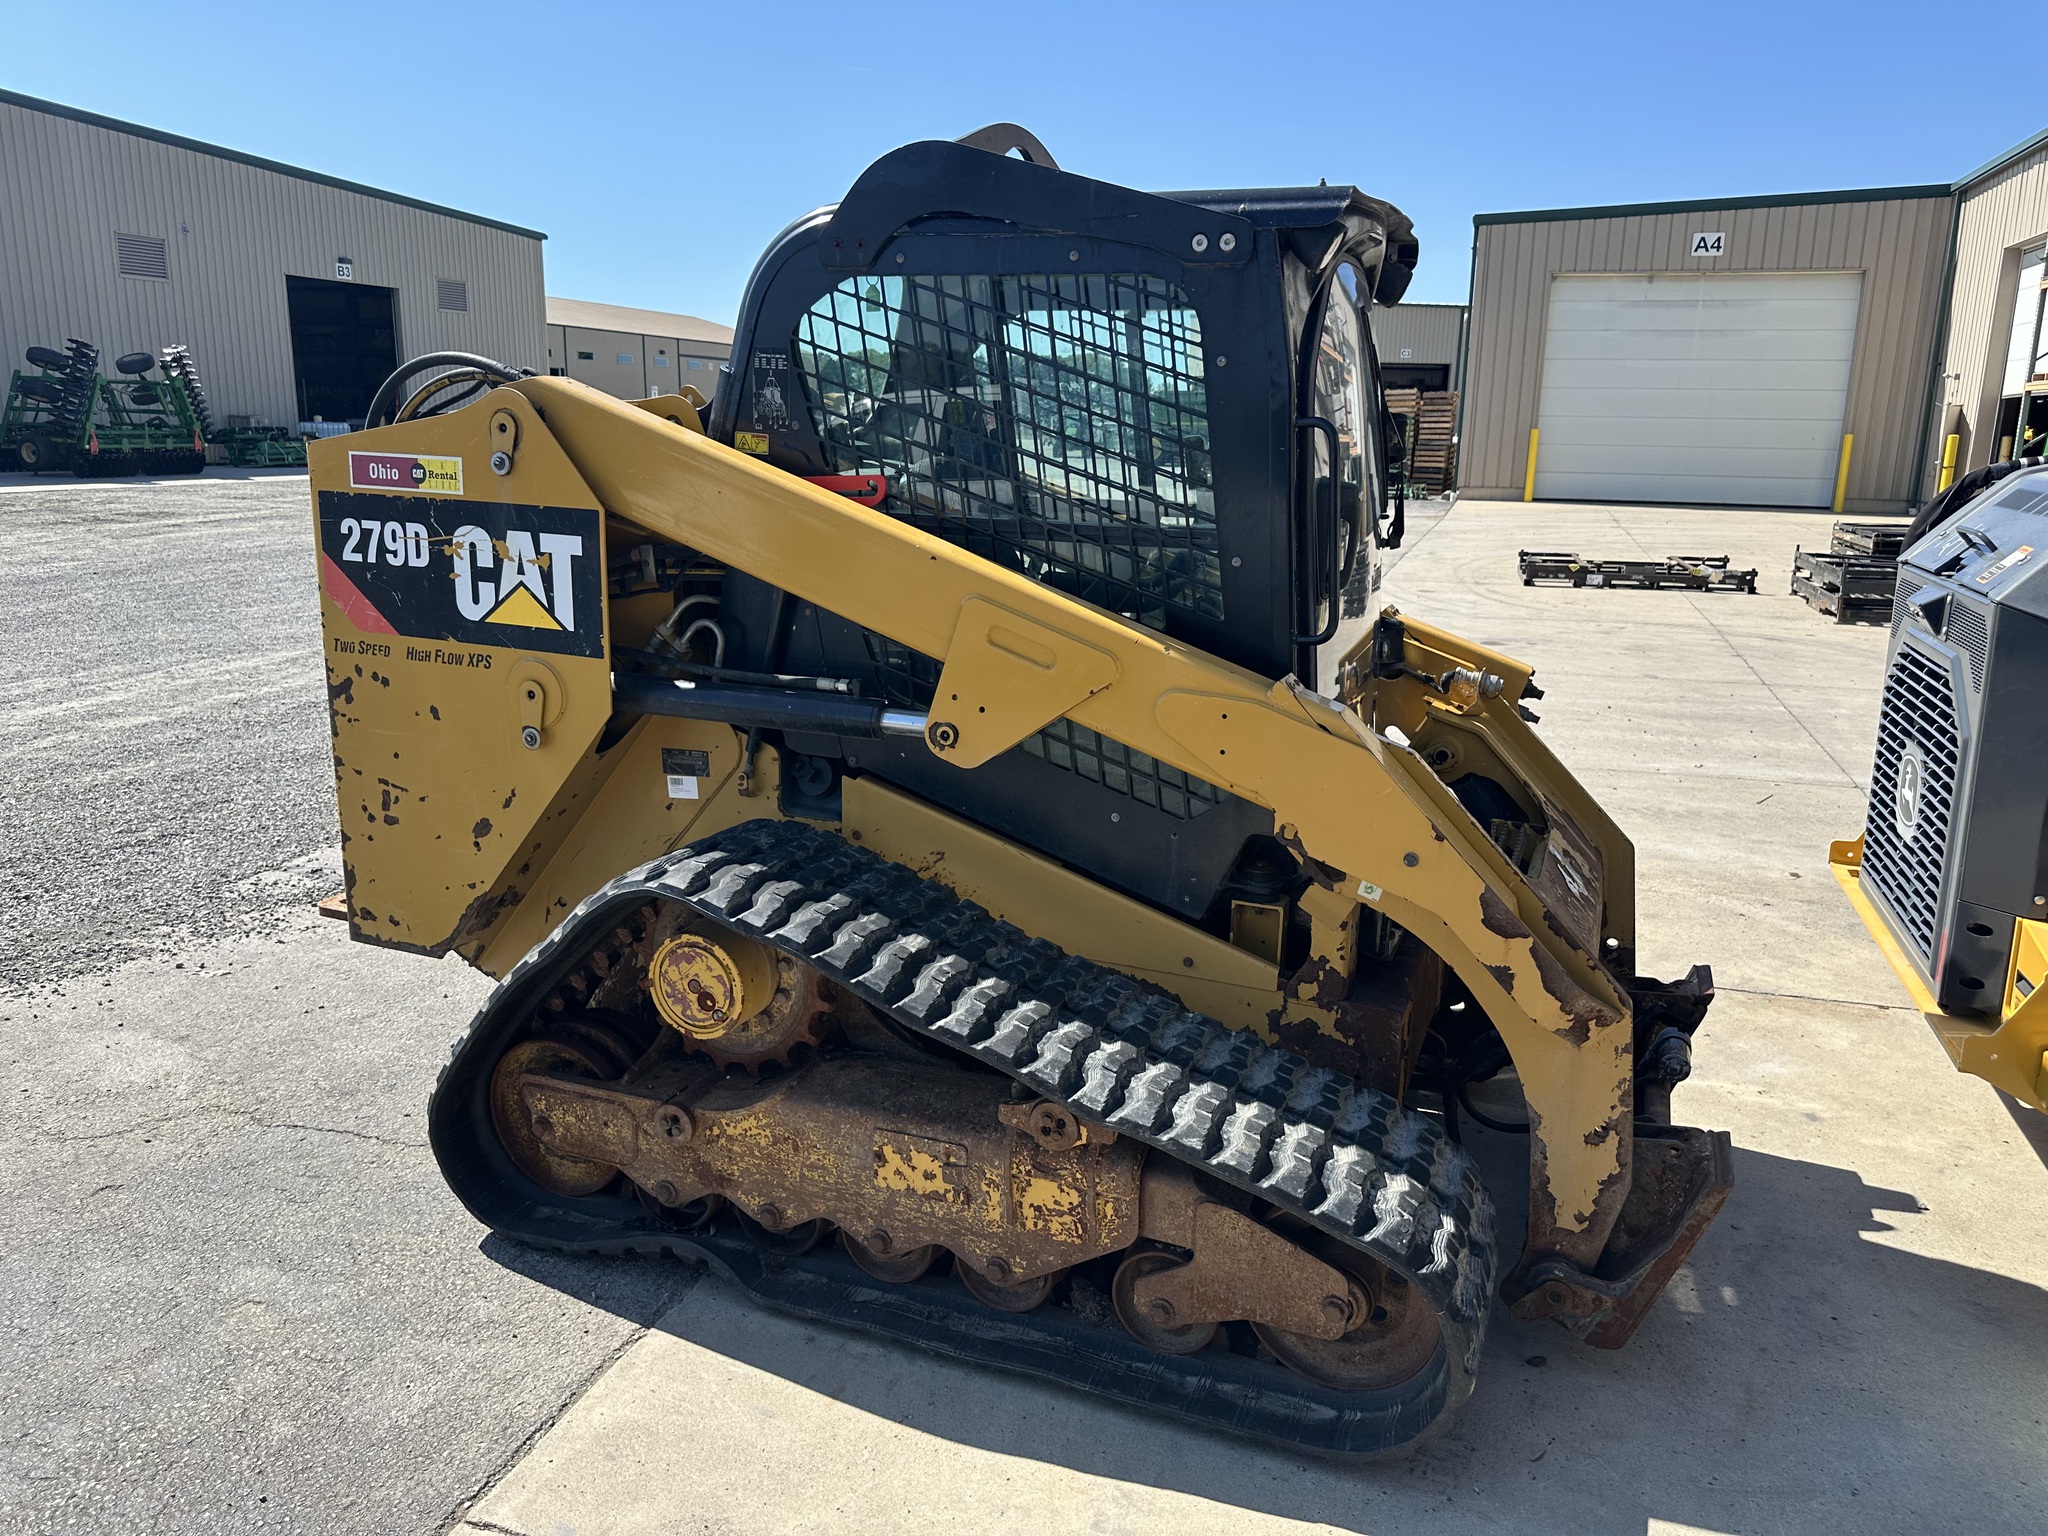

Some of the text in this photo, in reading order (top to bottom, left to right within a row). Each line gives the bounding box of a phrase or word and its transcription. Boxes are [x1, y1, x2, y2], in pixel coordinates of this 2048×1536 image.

[1693, 236, 1722, 252] A4
[337, 265, 350, 277] B3
[369, 463, 458, 481] Ohio CAT Rental
[340, 517, 583, 632] 279D CAT
[467, 653, 492, 669] XPS
